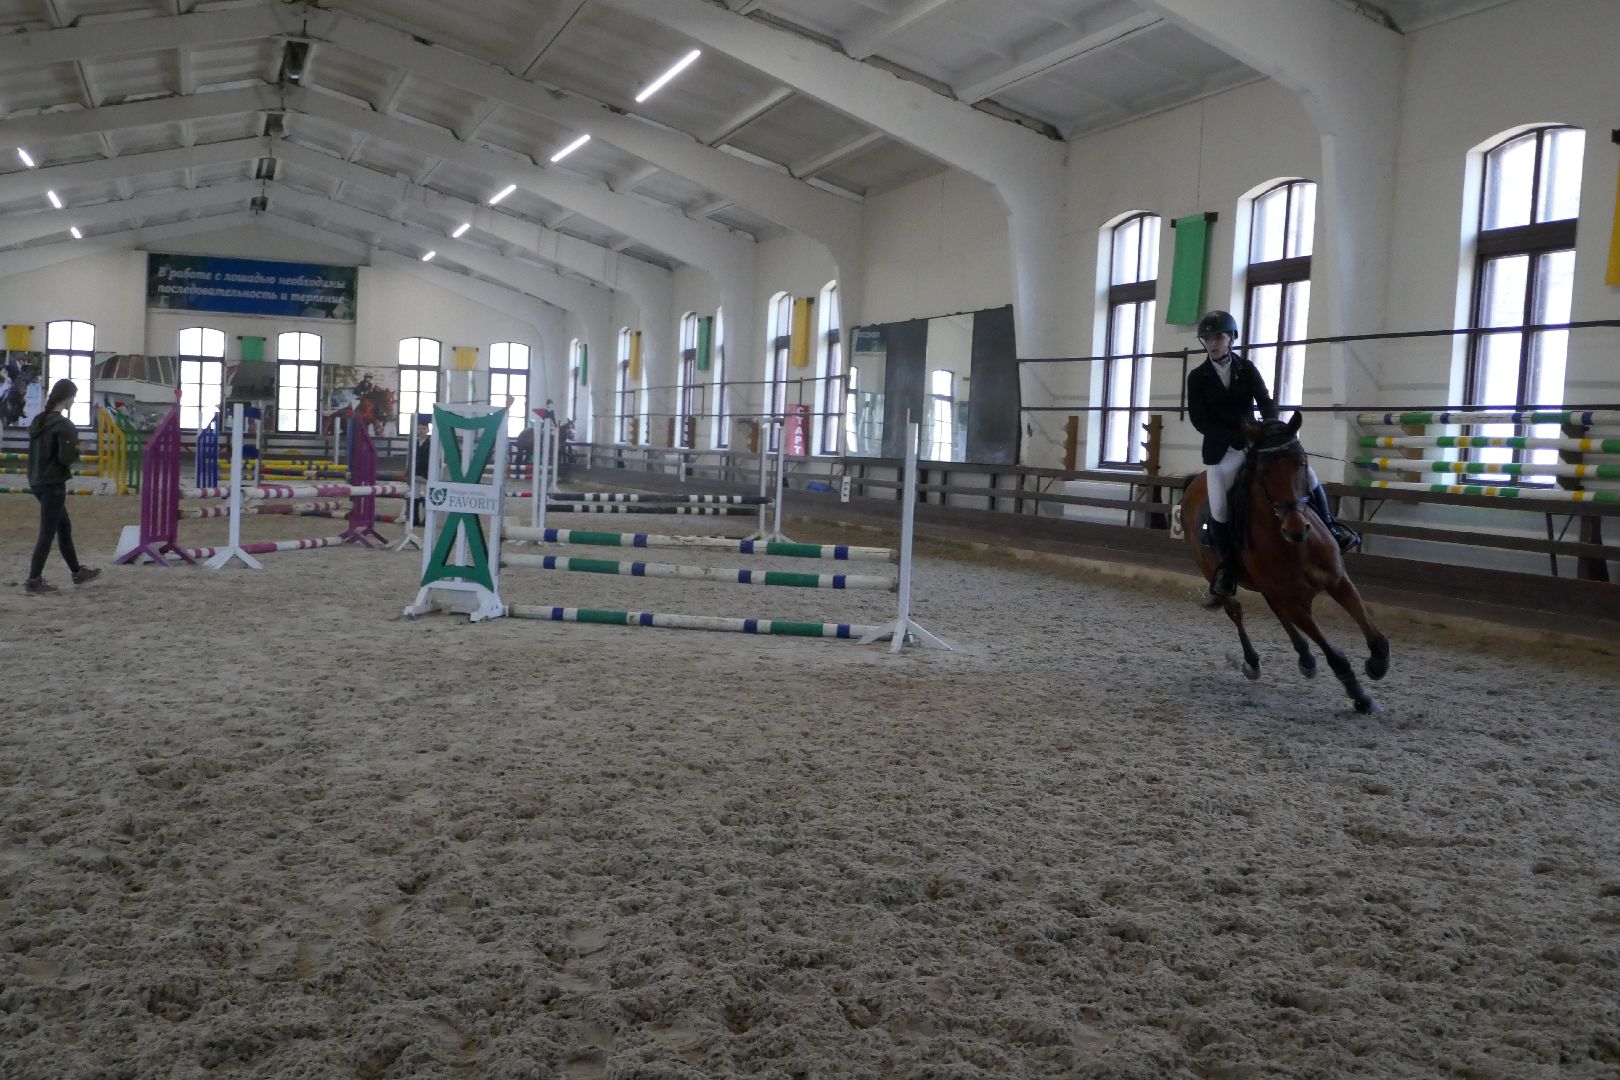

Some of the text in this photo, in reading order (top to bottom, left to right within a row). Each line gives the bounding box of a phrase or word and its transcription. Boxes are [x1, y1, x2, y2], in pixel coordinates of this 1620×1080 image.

[158, 266, 346, 289] В работе с лошадью необходимы
[157, 282, 345, 305] последовательность и терпение
[793, 406, 805, 455] СТАРТ
[448, 495, 498, 510] FAVORIT
